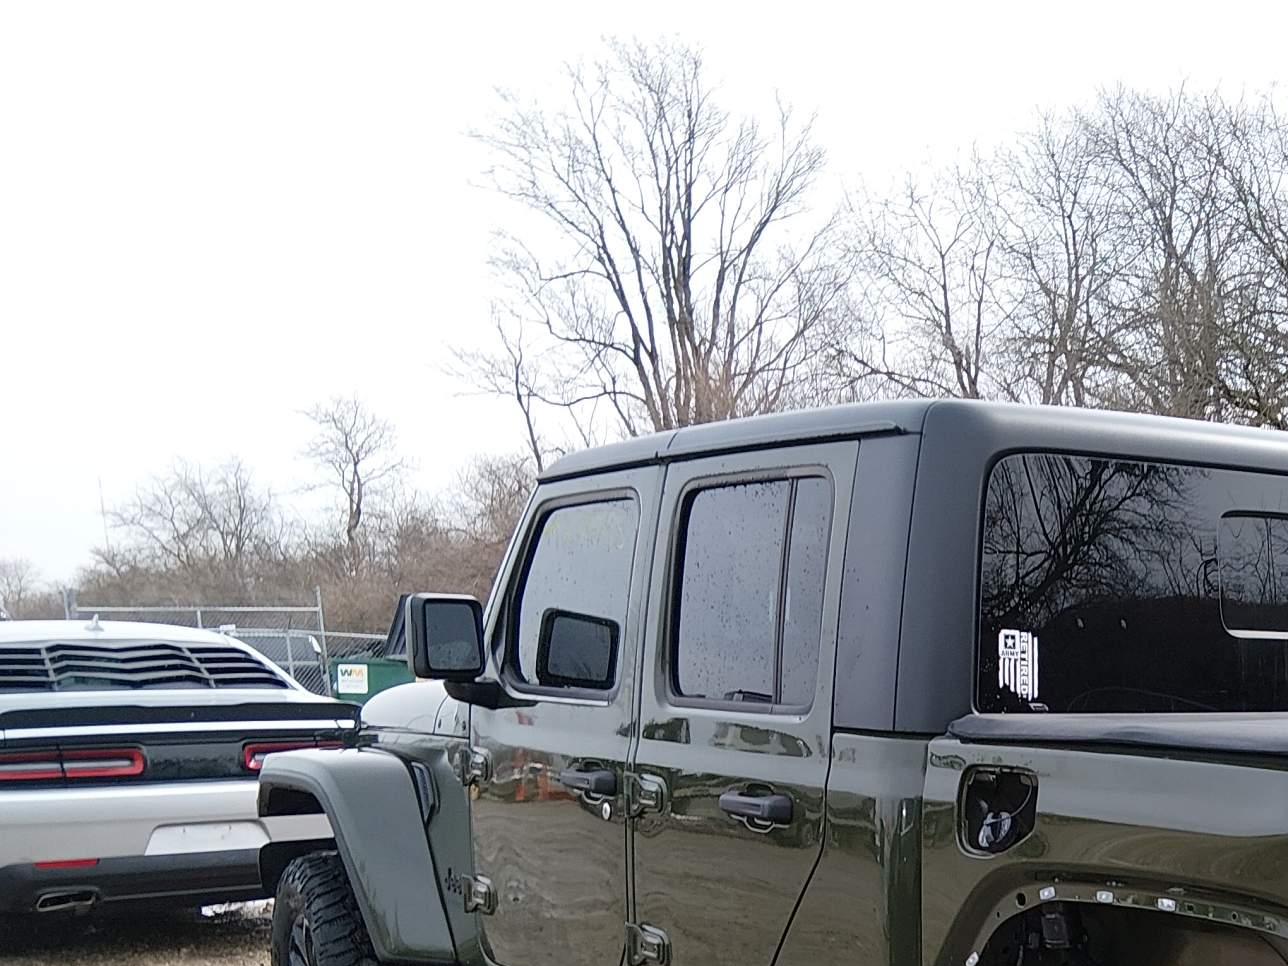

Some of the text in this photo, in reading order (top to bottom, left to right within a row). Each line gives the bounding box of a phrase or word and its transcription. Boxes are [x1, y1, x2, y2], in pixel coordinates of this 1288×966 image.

[1001, 649, 1019, 657] ARMY
[1020, 631, 1029, 695] RETIRED
[340, 668, 364, 677] WM
